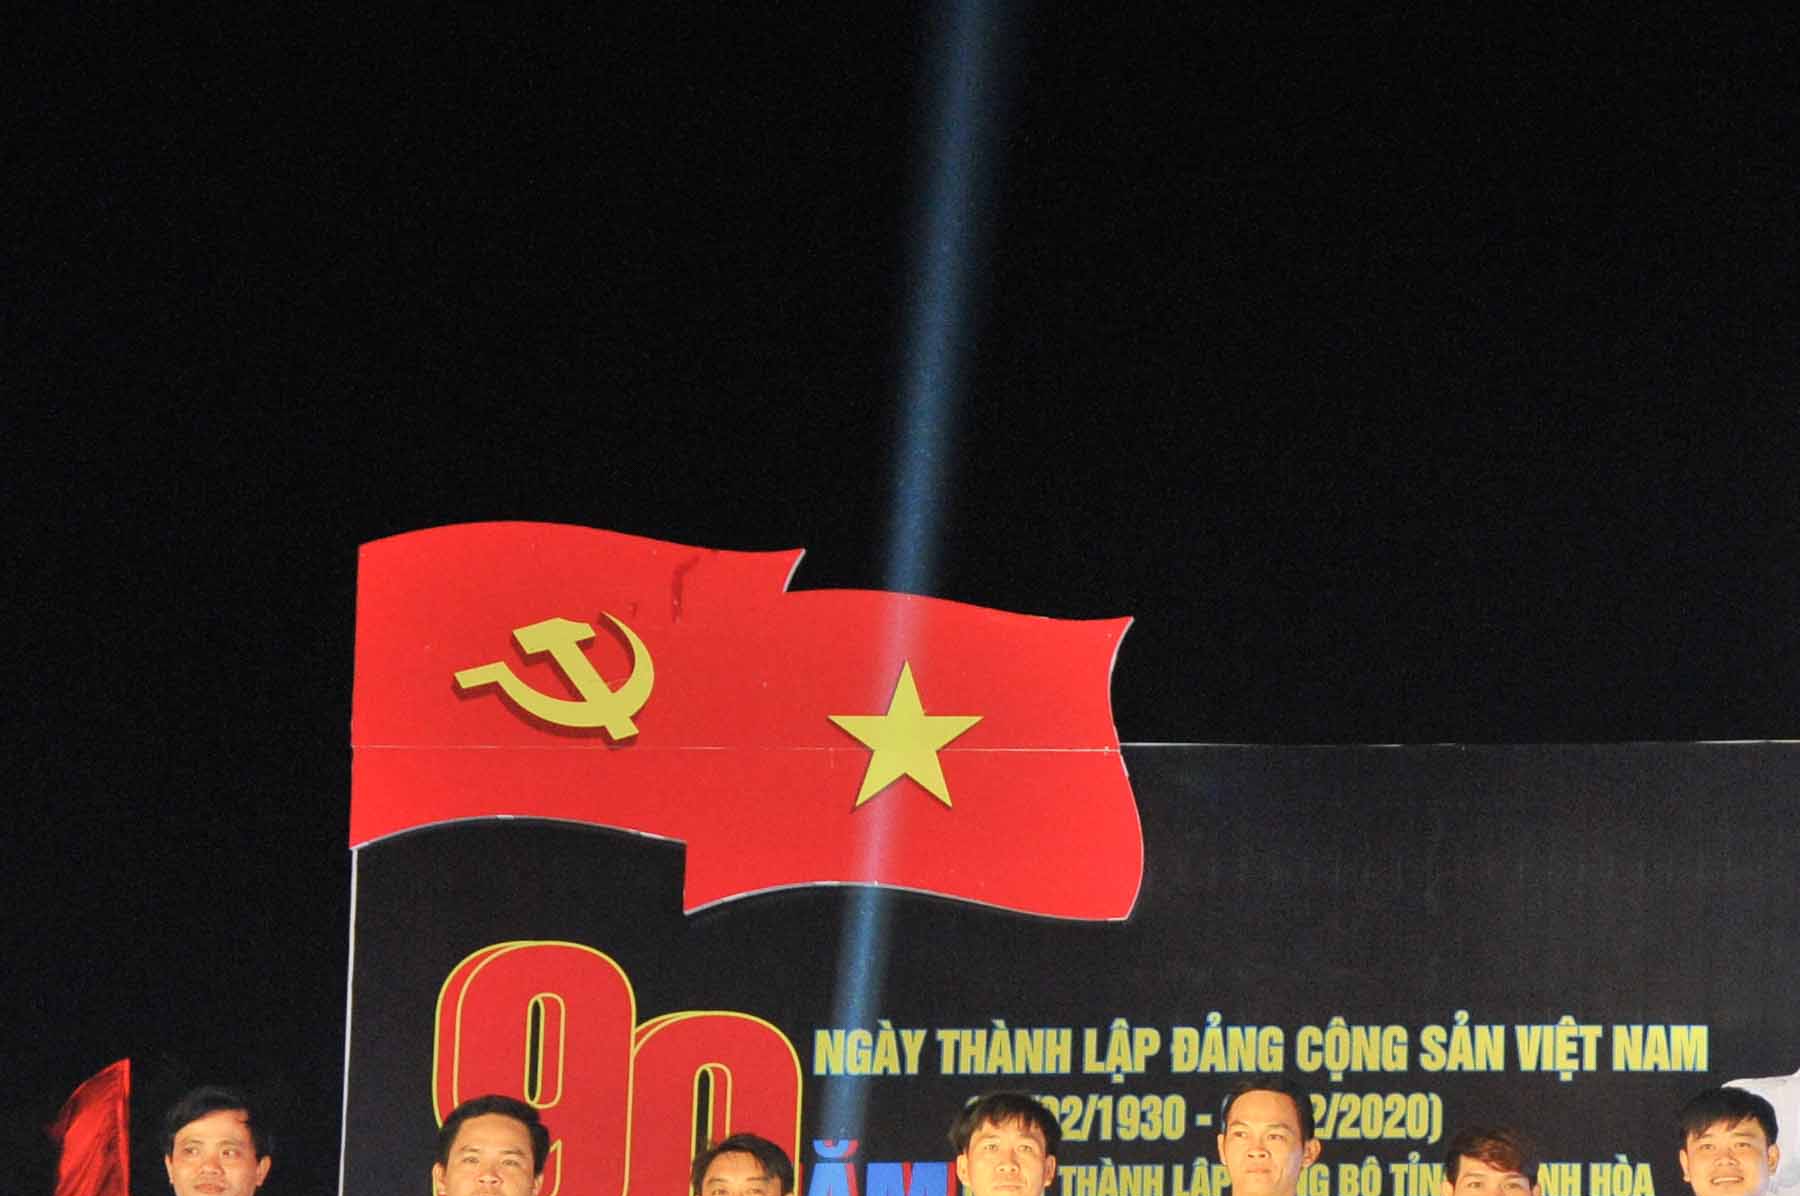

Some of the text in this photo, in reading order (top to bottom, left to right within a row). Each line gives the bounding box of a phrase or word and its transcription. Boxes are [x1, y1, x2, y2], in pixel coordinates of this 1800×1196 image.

[813, 1010, 1709, 1083] NGÀY THÀNH LẬP ĐẢNG CỘNG SẢN VIỆT NAM
